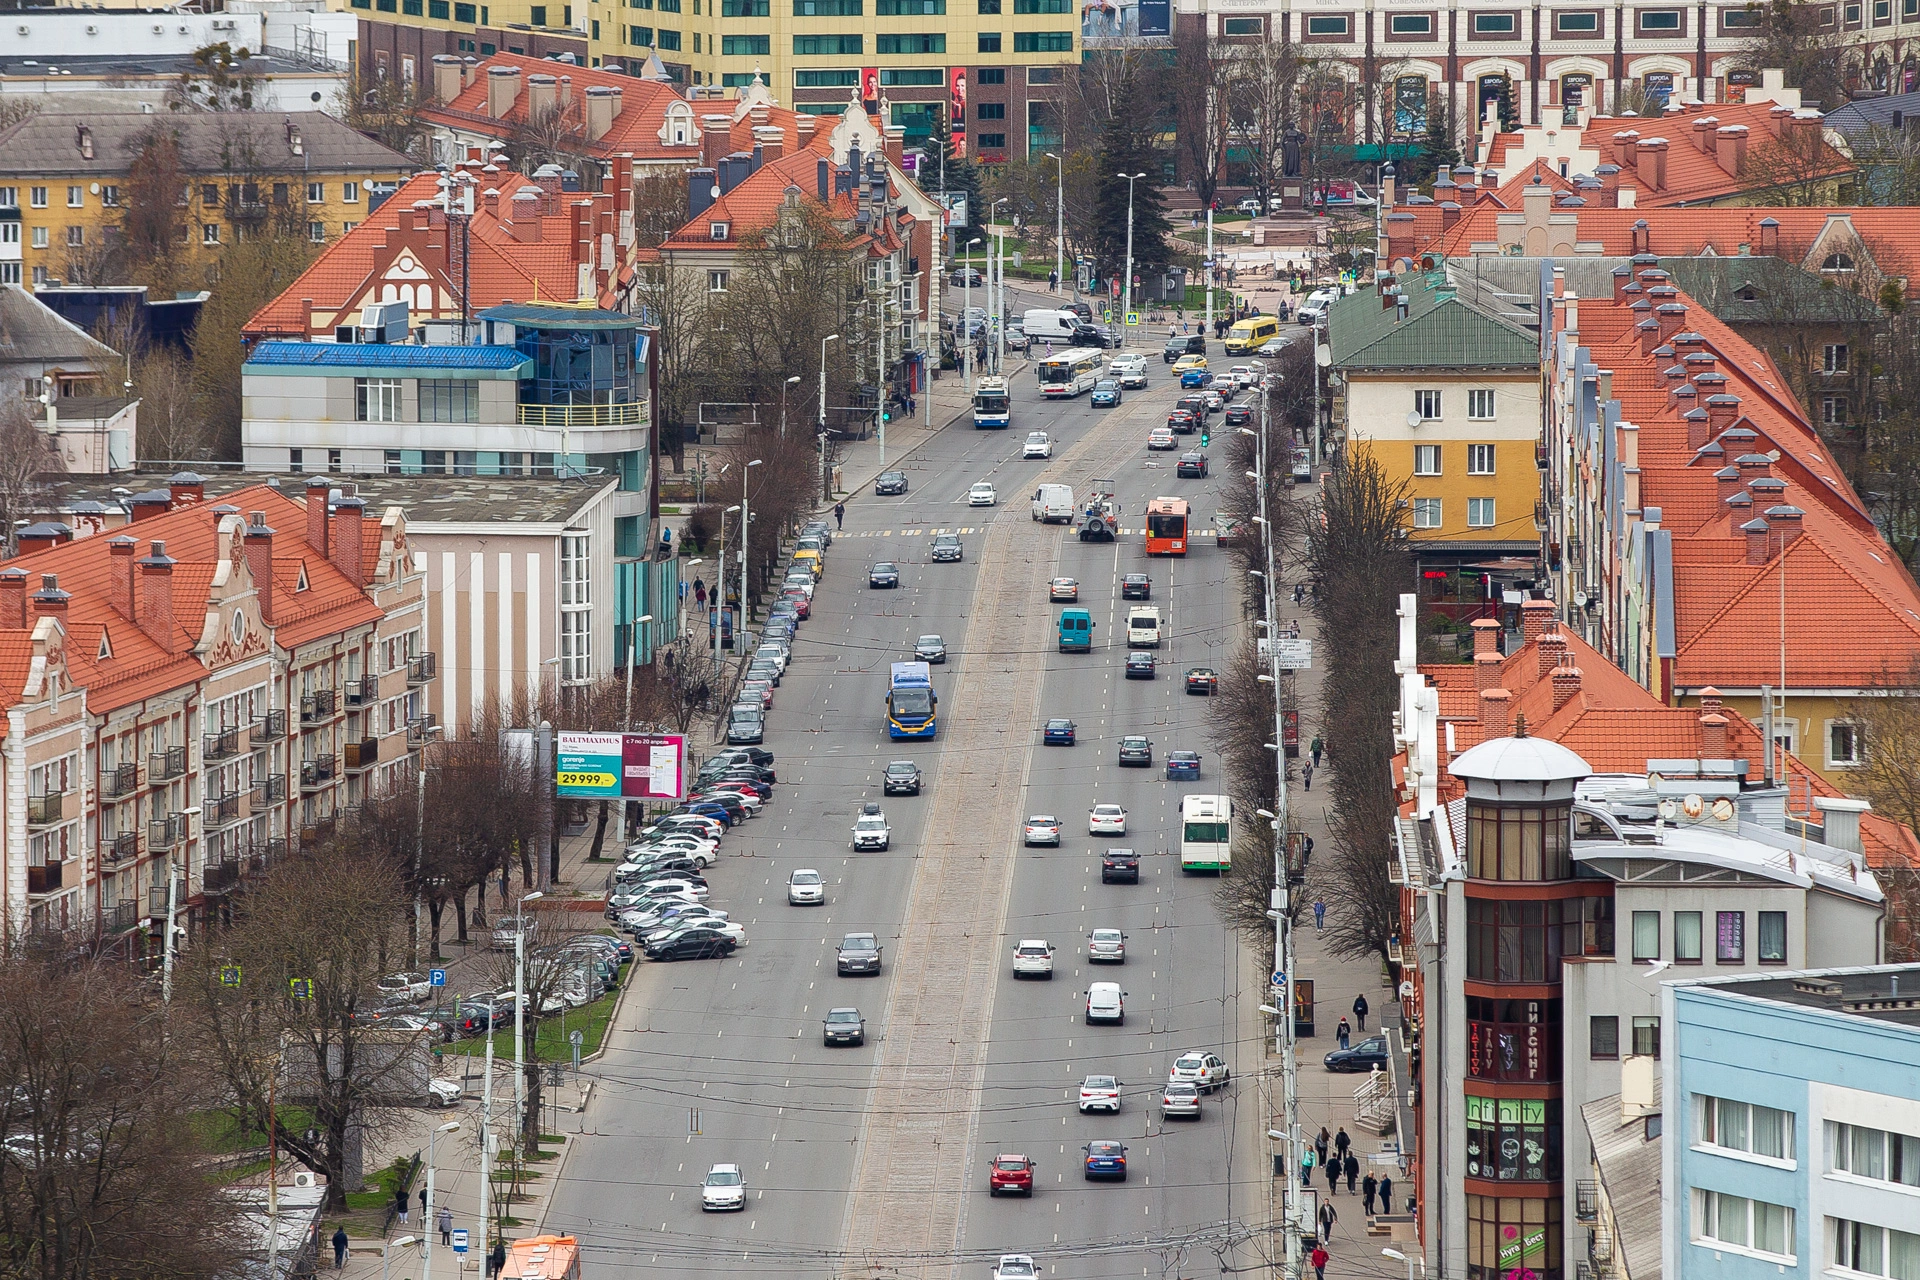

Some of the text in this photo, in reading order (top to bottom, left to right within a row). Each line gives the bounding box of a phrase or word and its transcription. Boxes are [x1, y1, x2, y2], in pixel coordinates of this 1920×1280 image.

[433, 971, 443, 984] P
[1485, 1027, 1493, 1070] ТАТУ
[1505, 1034, 1514, 1070] ТАТУ
[1527, 1002, 1538, 1080] ПИРСИНГ
[1467, 1099, 1542, 1123] Infinity
[1482, 1164, 1495, 1178] 50
[1526, 1167, 1541, 1179] 18
[1500, 1233, 1544, 1259] Нуга Бест
